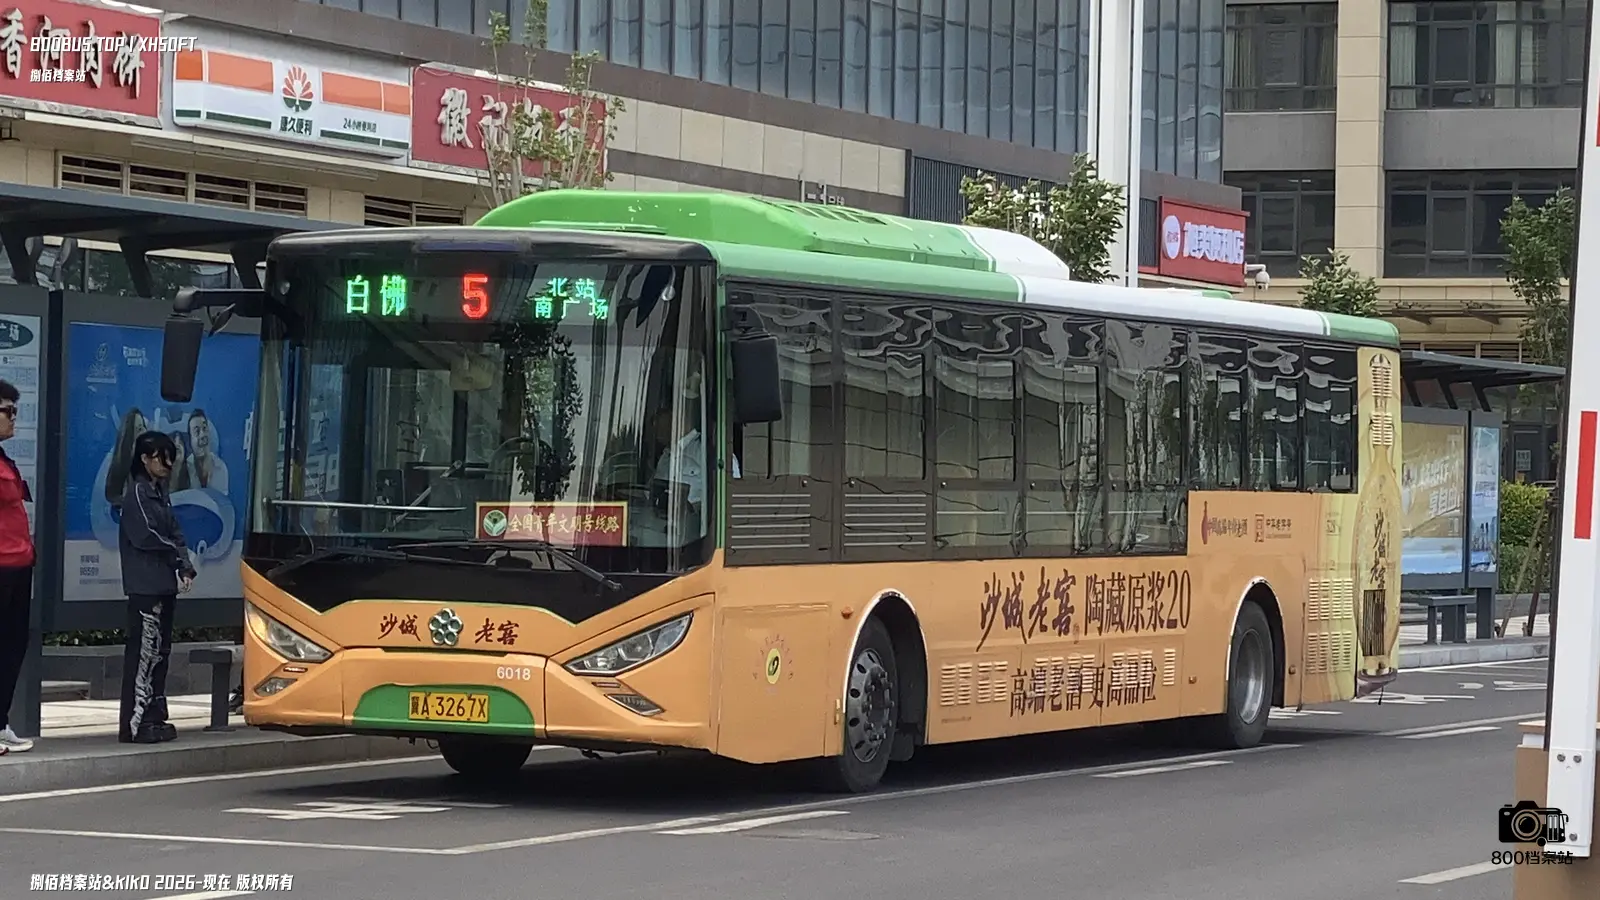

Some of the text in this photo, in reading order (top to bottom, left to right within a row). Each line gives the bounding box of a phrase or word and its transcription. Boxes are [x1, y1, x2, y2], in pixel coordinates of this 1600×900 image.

[0, 7, 146, 100] 香河肉饼
[346, 273, 489, 319] 白佛 5
[547, 277, 596, 299] 北站
[534, 297, 609, 320] 南广场
[508, 513, 620, 534] 全国青年文明号线路
[377, 612, 520, 646] 沙城 老窖
[496, 666, 532, 681] 6018
